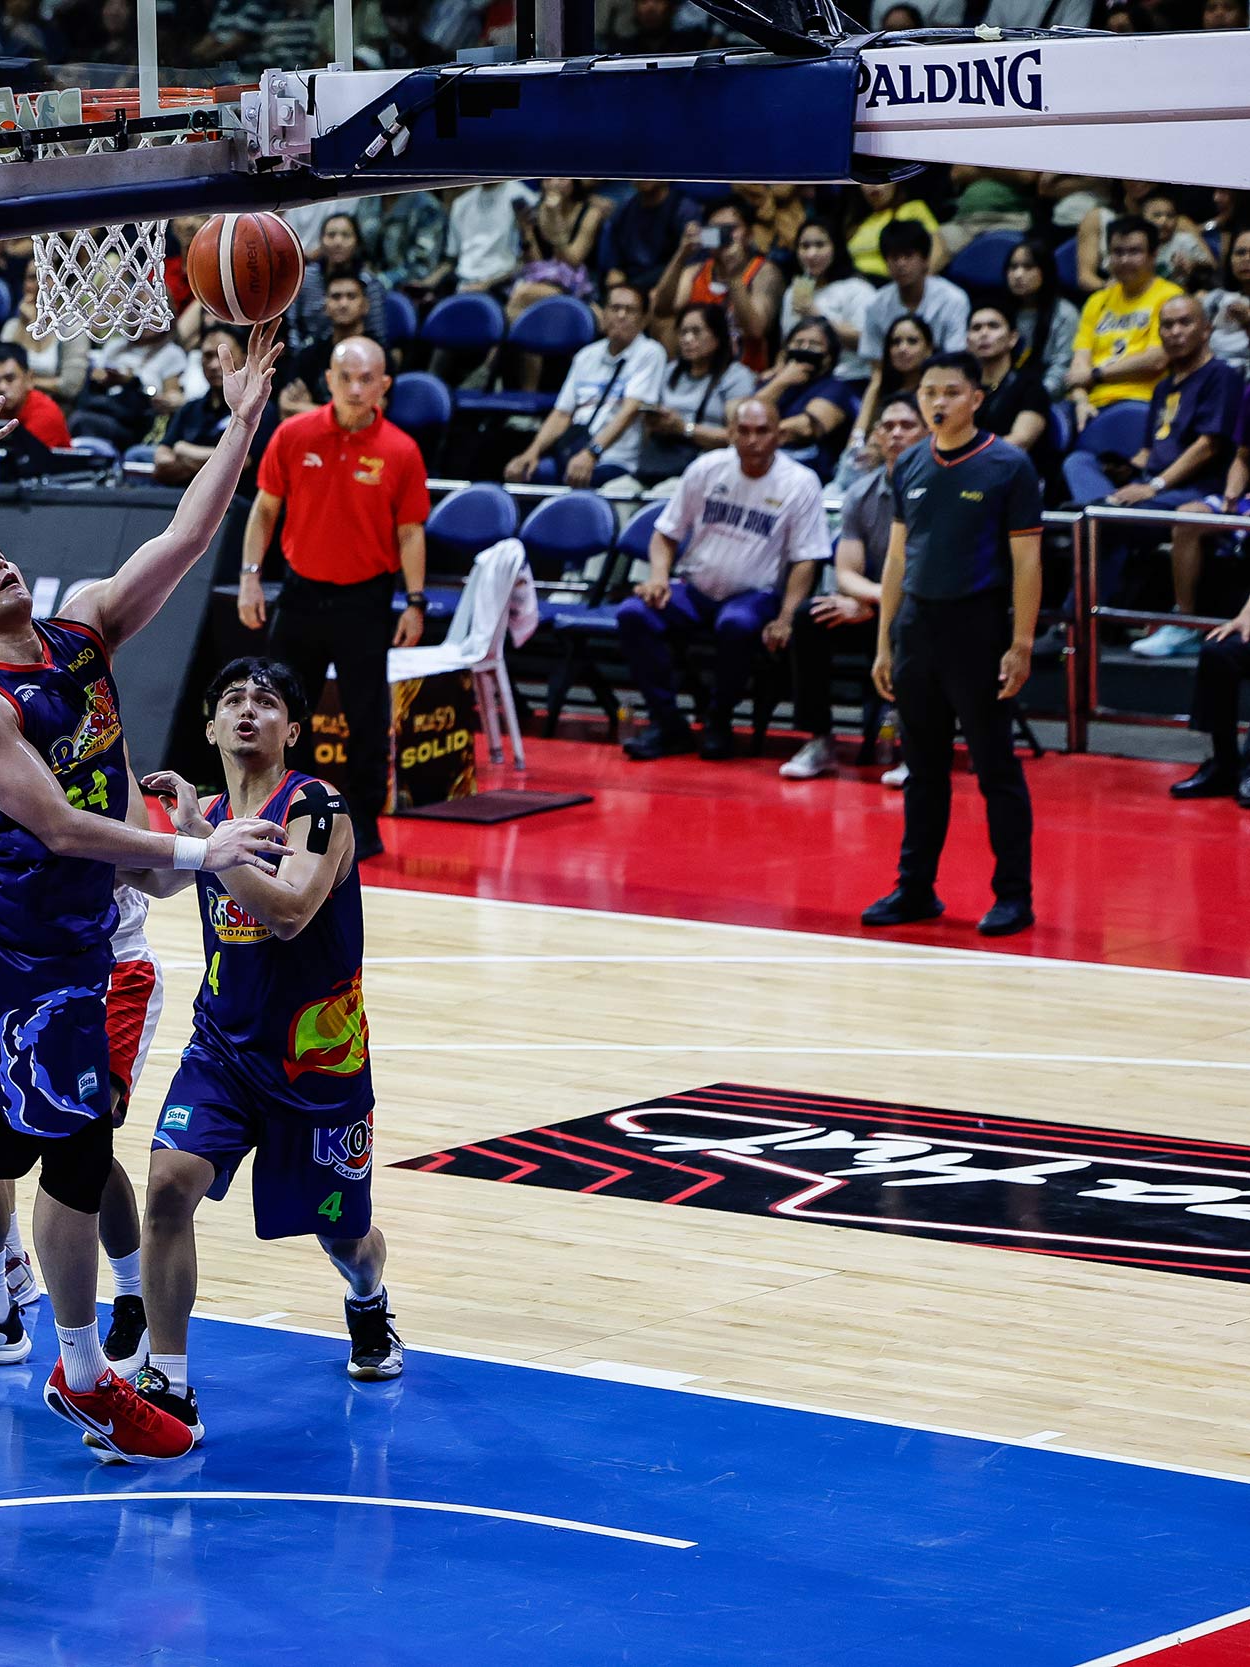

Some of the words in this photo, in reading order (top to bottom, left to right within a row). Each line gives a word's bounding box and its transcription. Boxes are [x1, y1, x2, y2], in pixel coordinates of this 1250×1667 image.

[857, 49, 1042, 111] PALDING
[401, 728, 468, 769] SOLID
[208, 951, 221, 996] 4
[167, 1110, 186, 1120] Sista
[317, 1191, 343, 1222] 4
